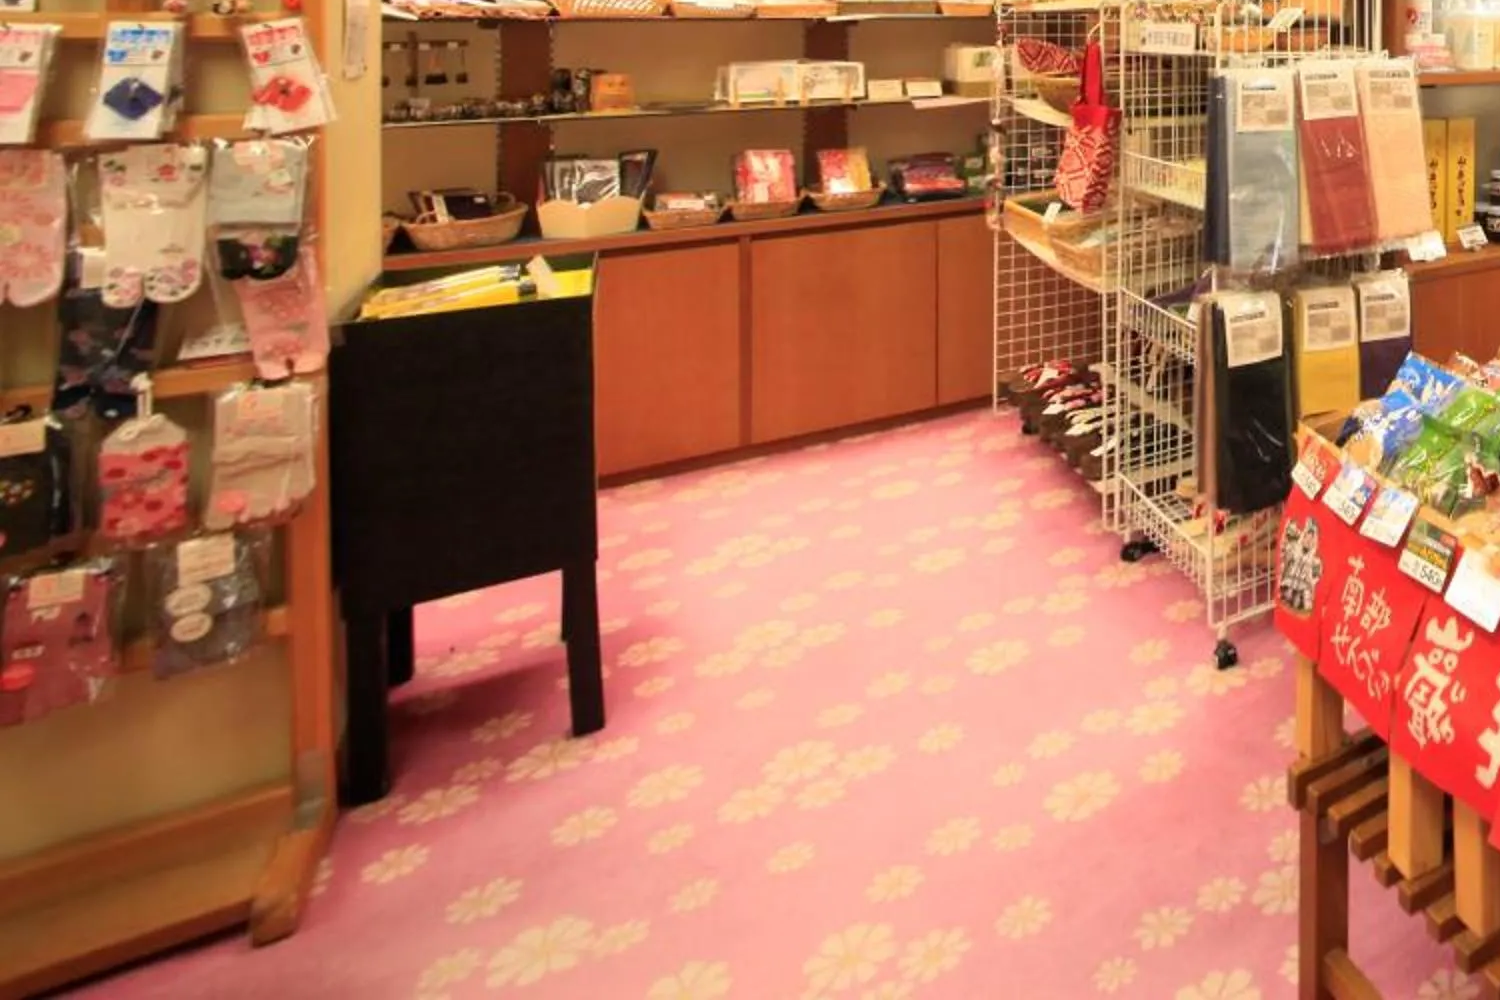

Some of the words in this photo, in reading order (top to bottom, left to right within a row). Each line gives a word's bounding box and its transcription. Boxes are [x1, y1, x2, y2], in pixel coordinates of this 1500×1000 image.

[1341, 555, 1392, 639] 南部
[1330, 621, 1402, 700] せんべい
